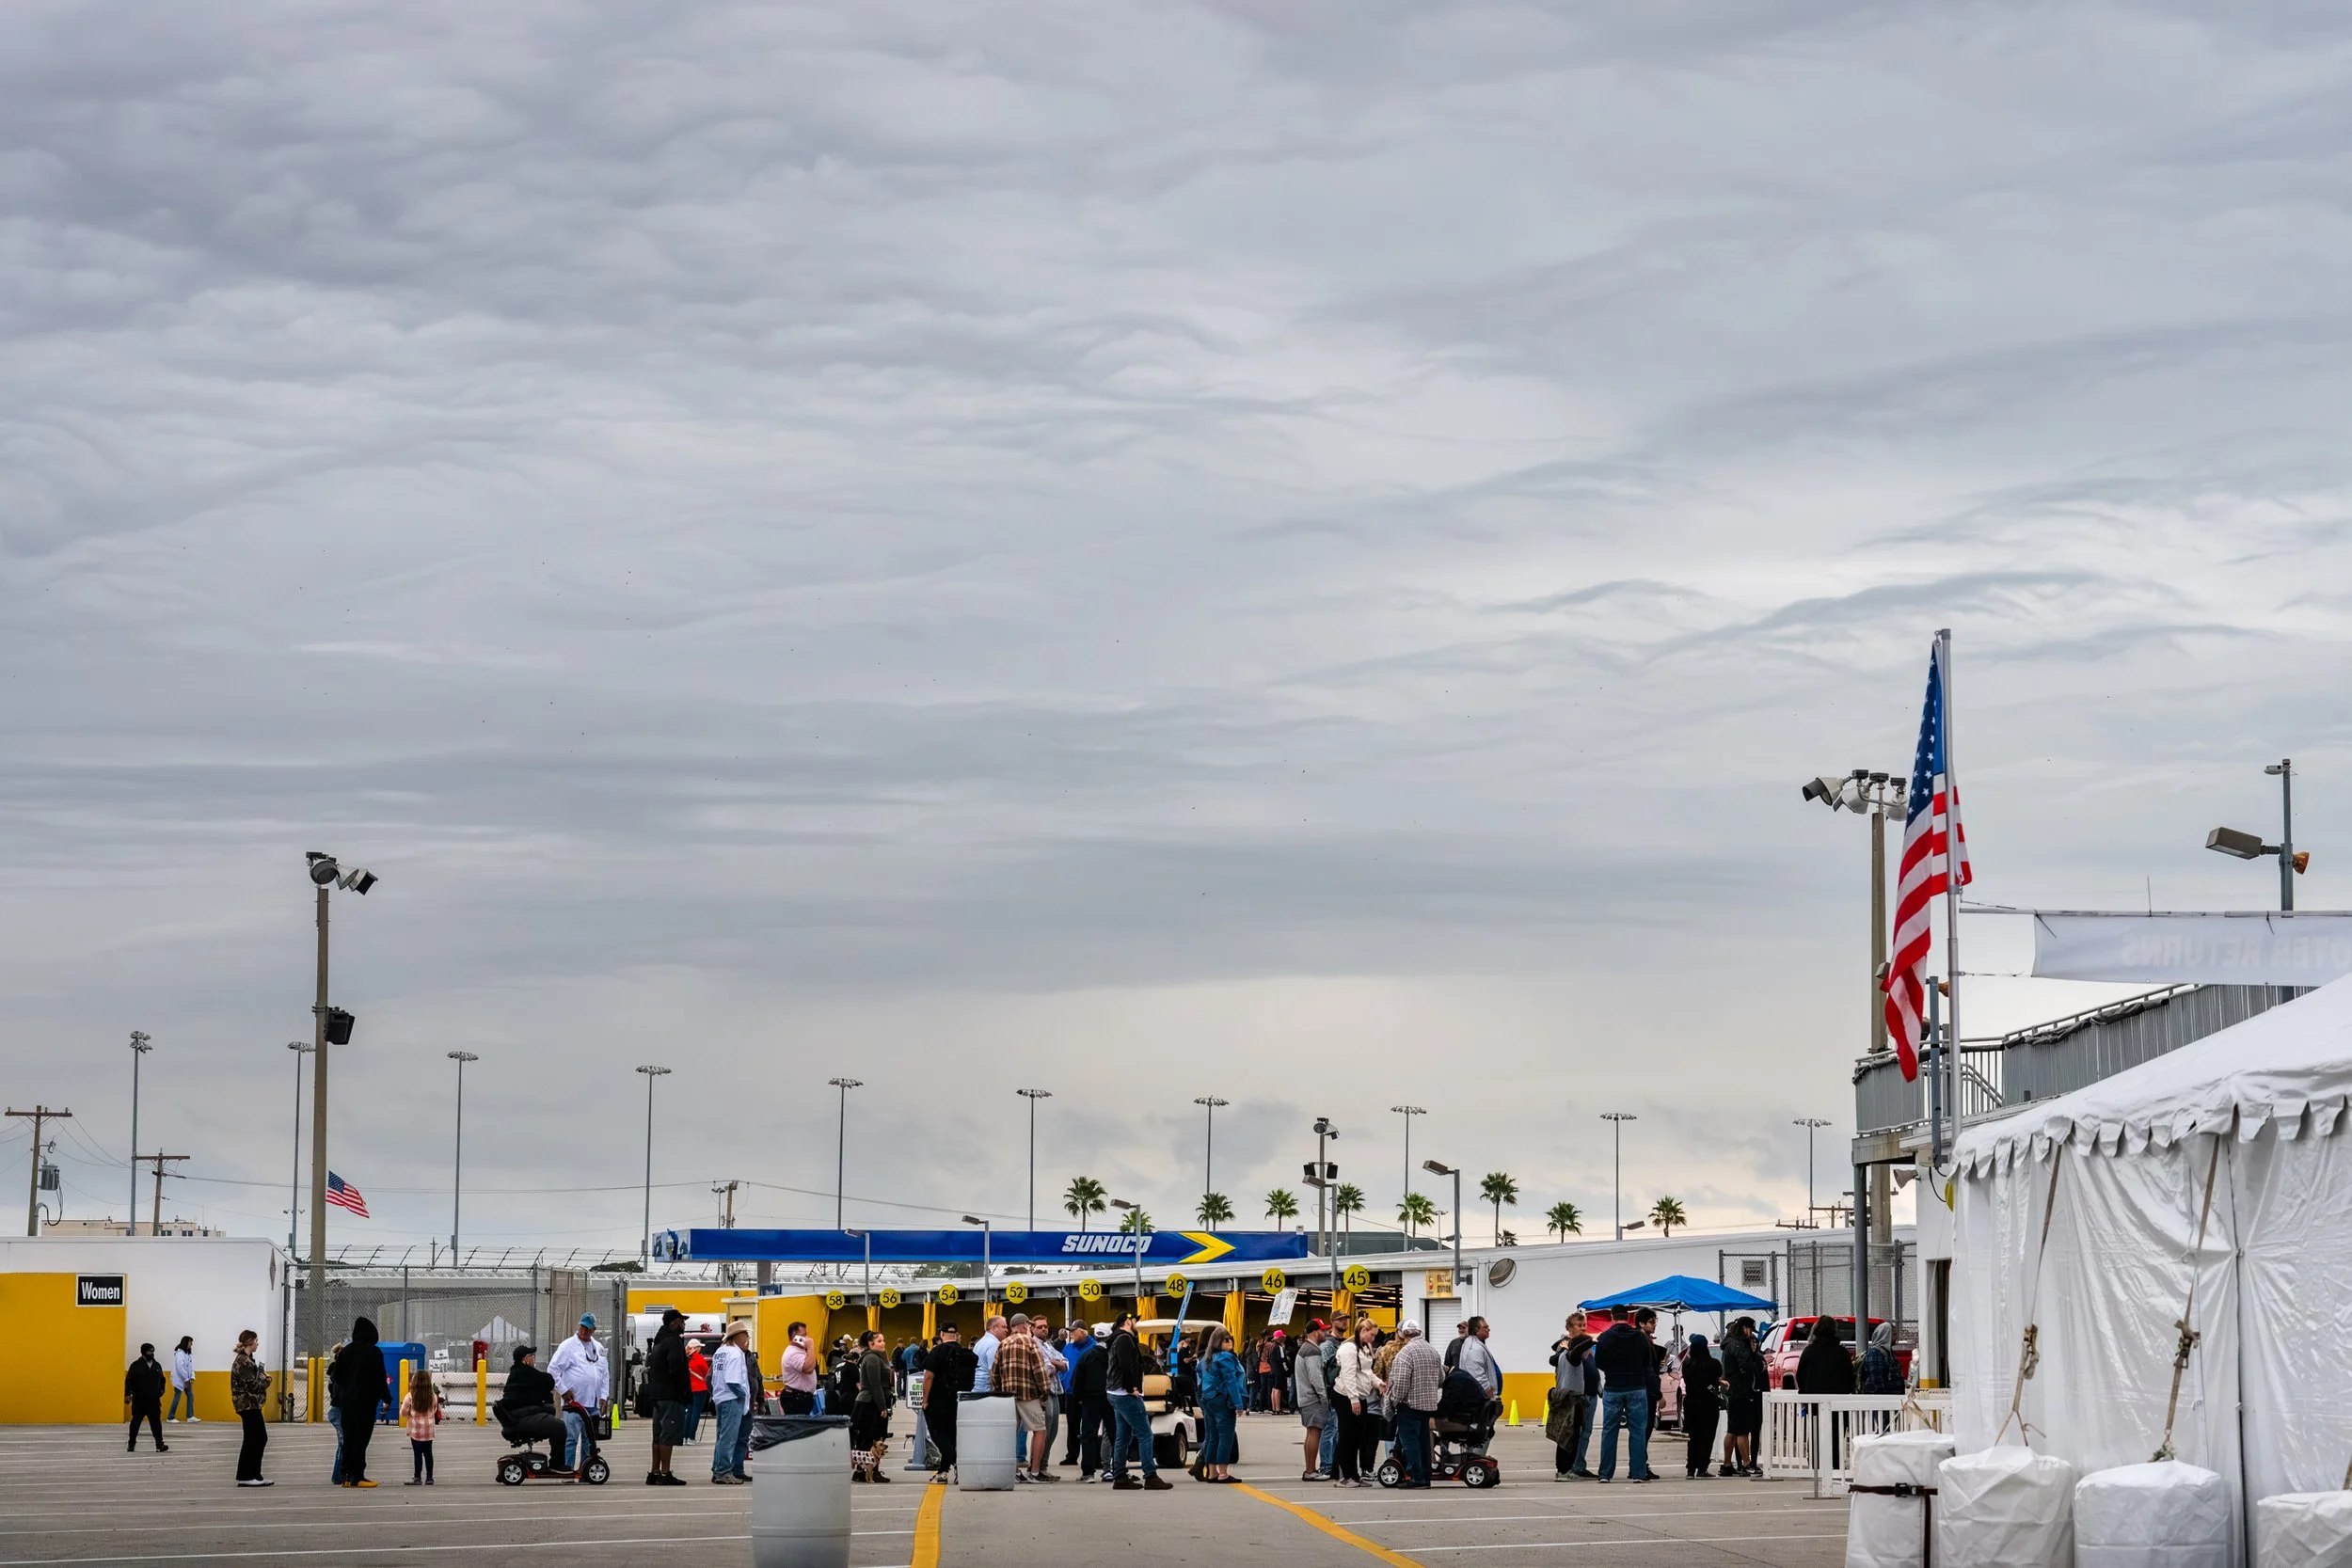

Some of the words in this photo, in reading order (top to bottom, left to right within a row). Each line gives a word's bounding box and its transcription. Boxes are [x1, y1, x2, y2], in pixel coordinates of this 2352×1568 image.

[1061, 1235, 1152, 1253] SUNOCO
[1168, 1278, 1184, 1292] 48
[1264, 1274, 1282, 1289] 46
[1347, 1272, 1367, 1286] 45
[81, 1281, 120, 1300] Women
[941, 1289, 956, 1301] 54
[1009, 1286, 1025, 1298] 52
[1083, 1283, 1100, 1296] 50
[828, 1295, 843, 1306] 58
[882, 1292, 898, 1304] 56
